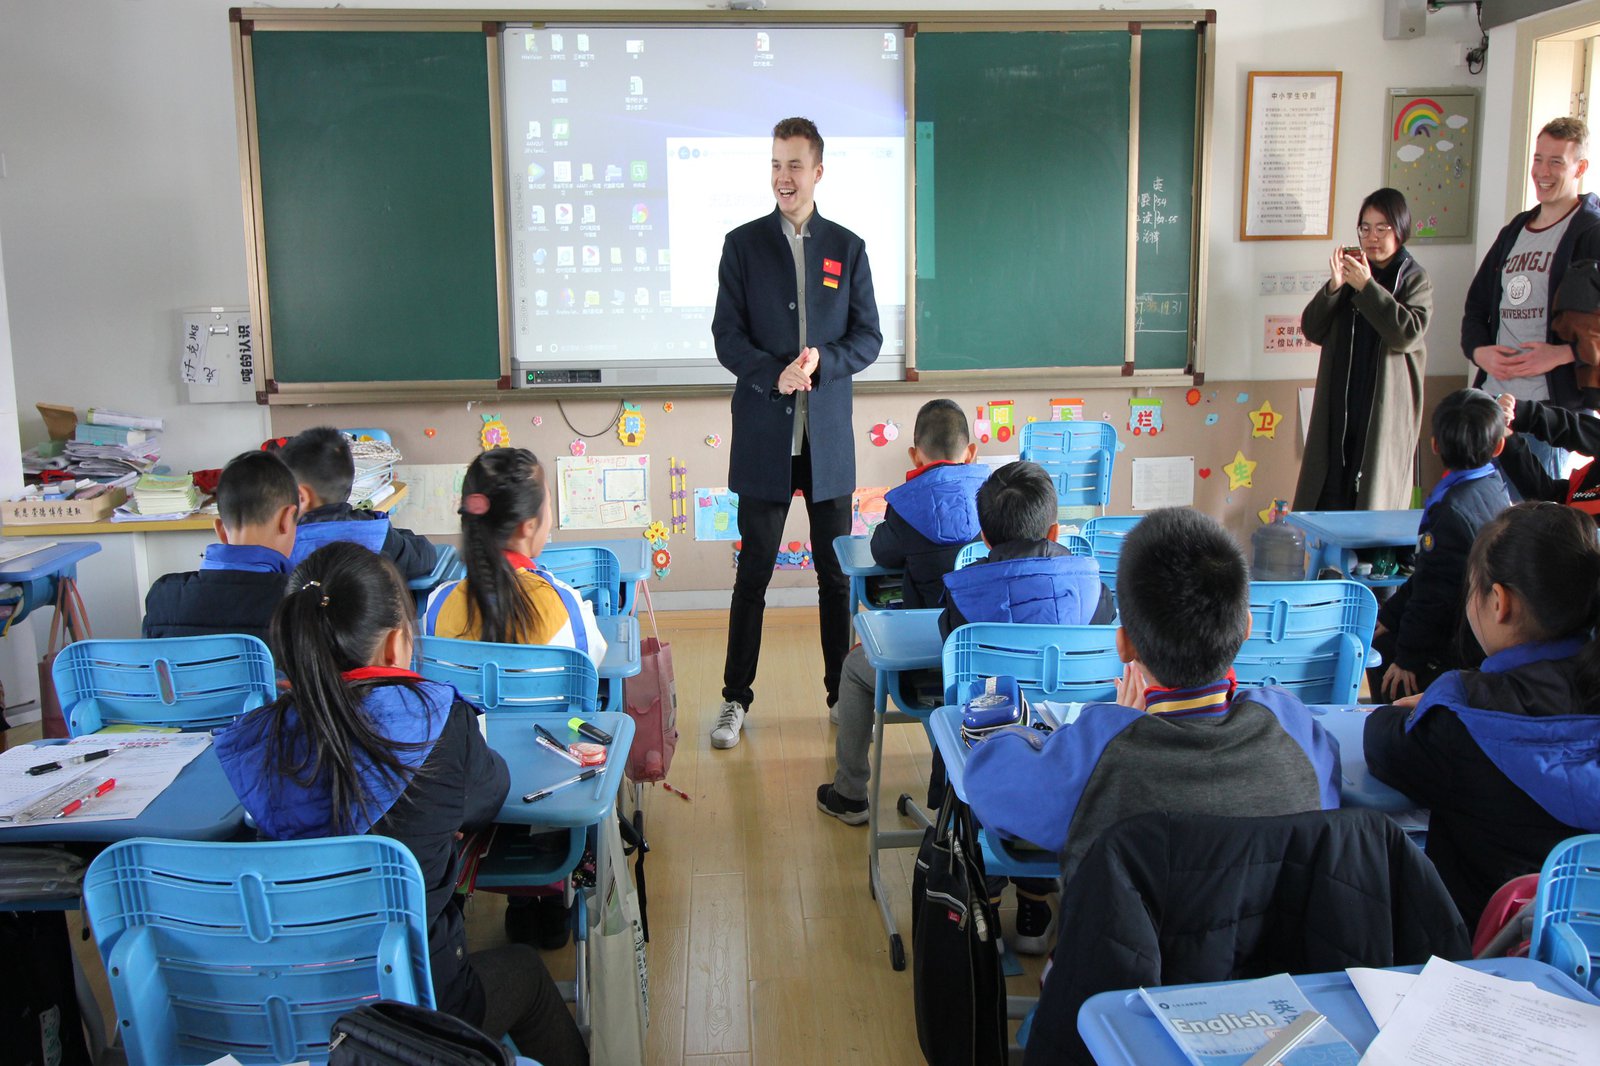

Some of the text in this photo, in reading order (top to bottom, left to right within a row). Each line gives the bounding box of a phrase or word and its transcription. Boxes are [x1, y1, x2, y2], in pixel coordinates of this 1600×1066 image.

[1503, 251, 1552, 274] ONGJ
[1501, 307, 1544, 319] NIVERSITY
[238, 325, 253, 382] 吨的认识
[1137, 410, 1153, 427] 栏
[1256, 412, 1274, 431] 卫
[1233, 461, 1250, 482] 生
[1170, 1010, 1275, 1035] English
